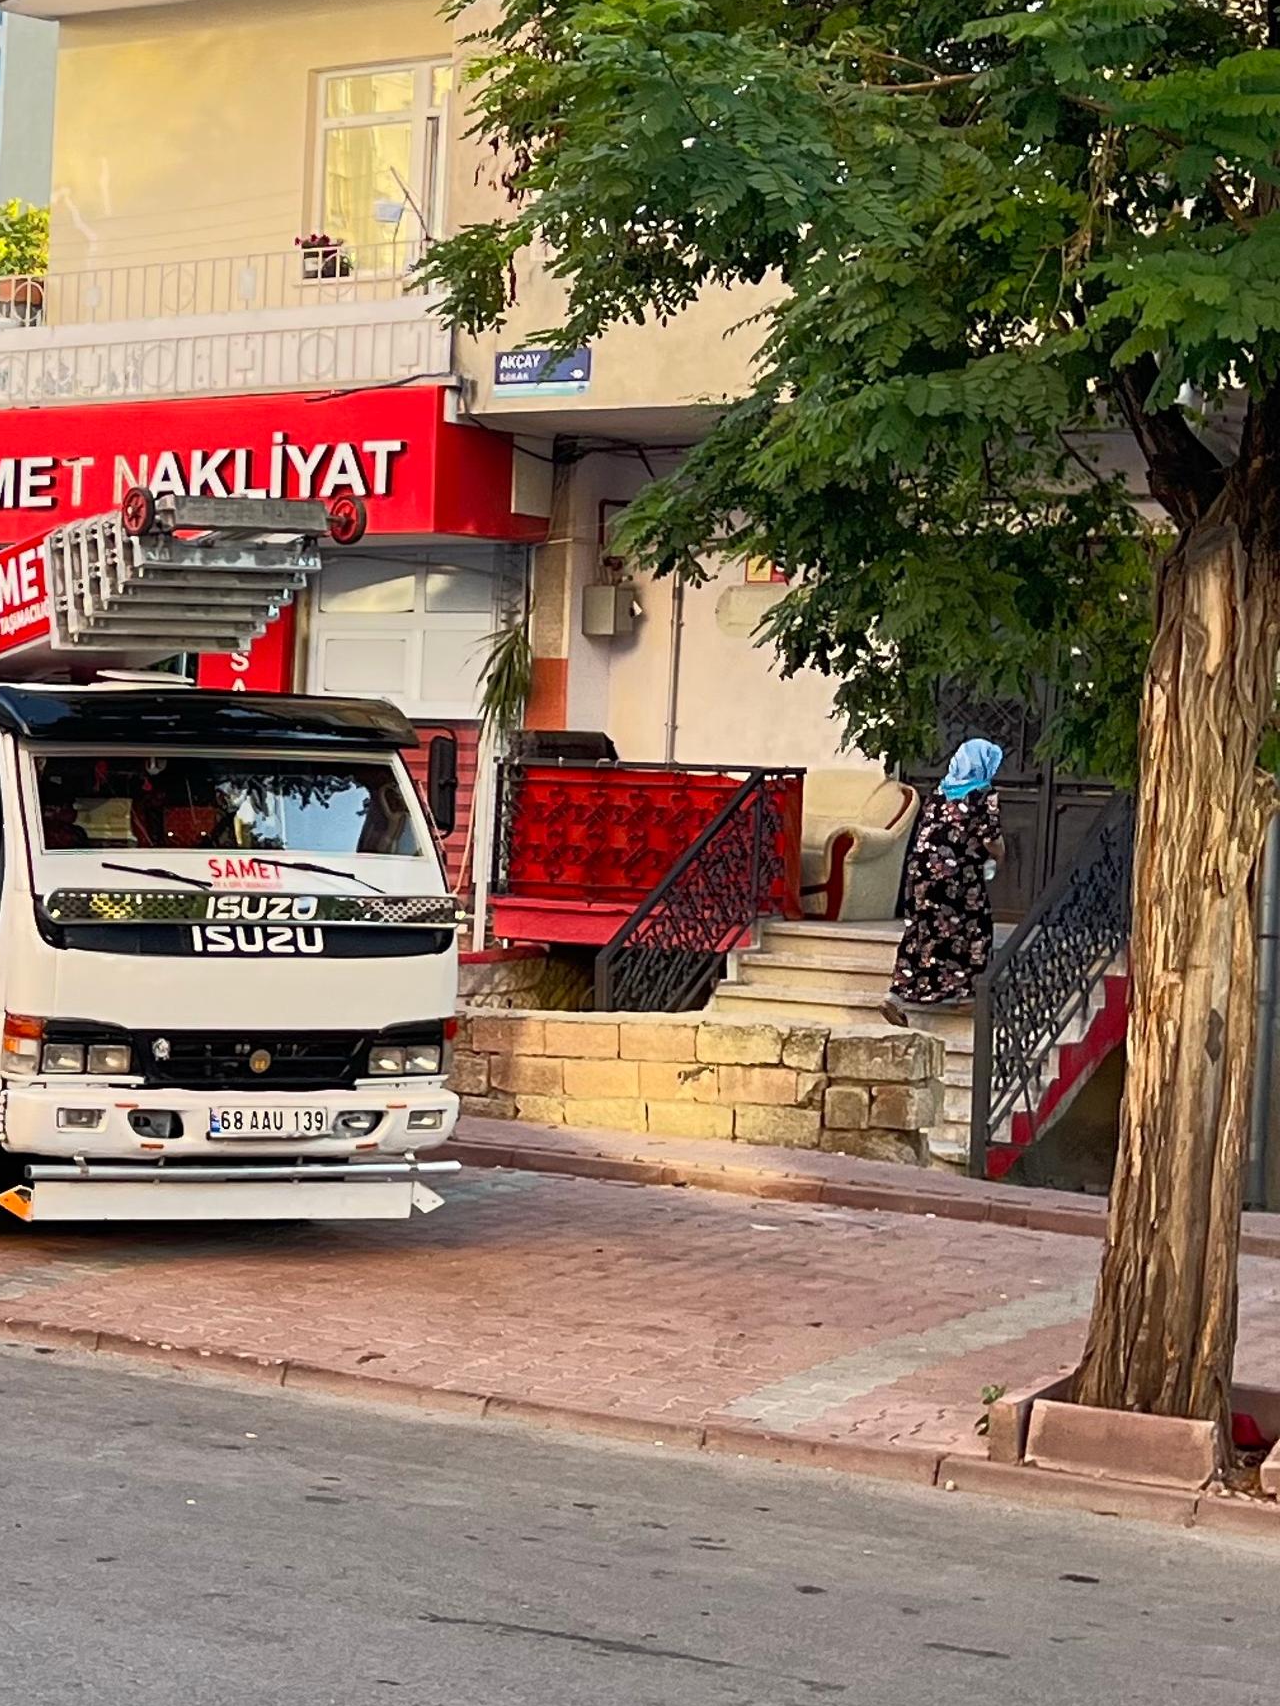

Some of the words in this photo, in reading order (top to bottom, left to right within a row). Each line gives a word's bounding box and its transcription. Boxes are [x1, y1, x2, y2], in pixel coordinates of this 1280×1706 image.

[111, 431, 404, 504] NAKLİYAT
[192, 925, 324, 953] ISUZU
[221, 1111, 243, 1130] 68
[250, 1111, 284, 1131] AAU
[294, 1111, 324, 1131] 139
